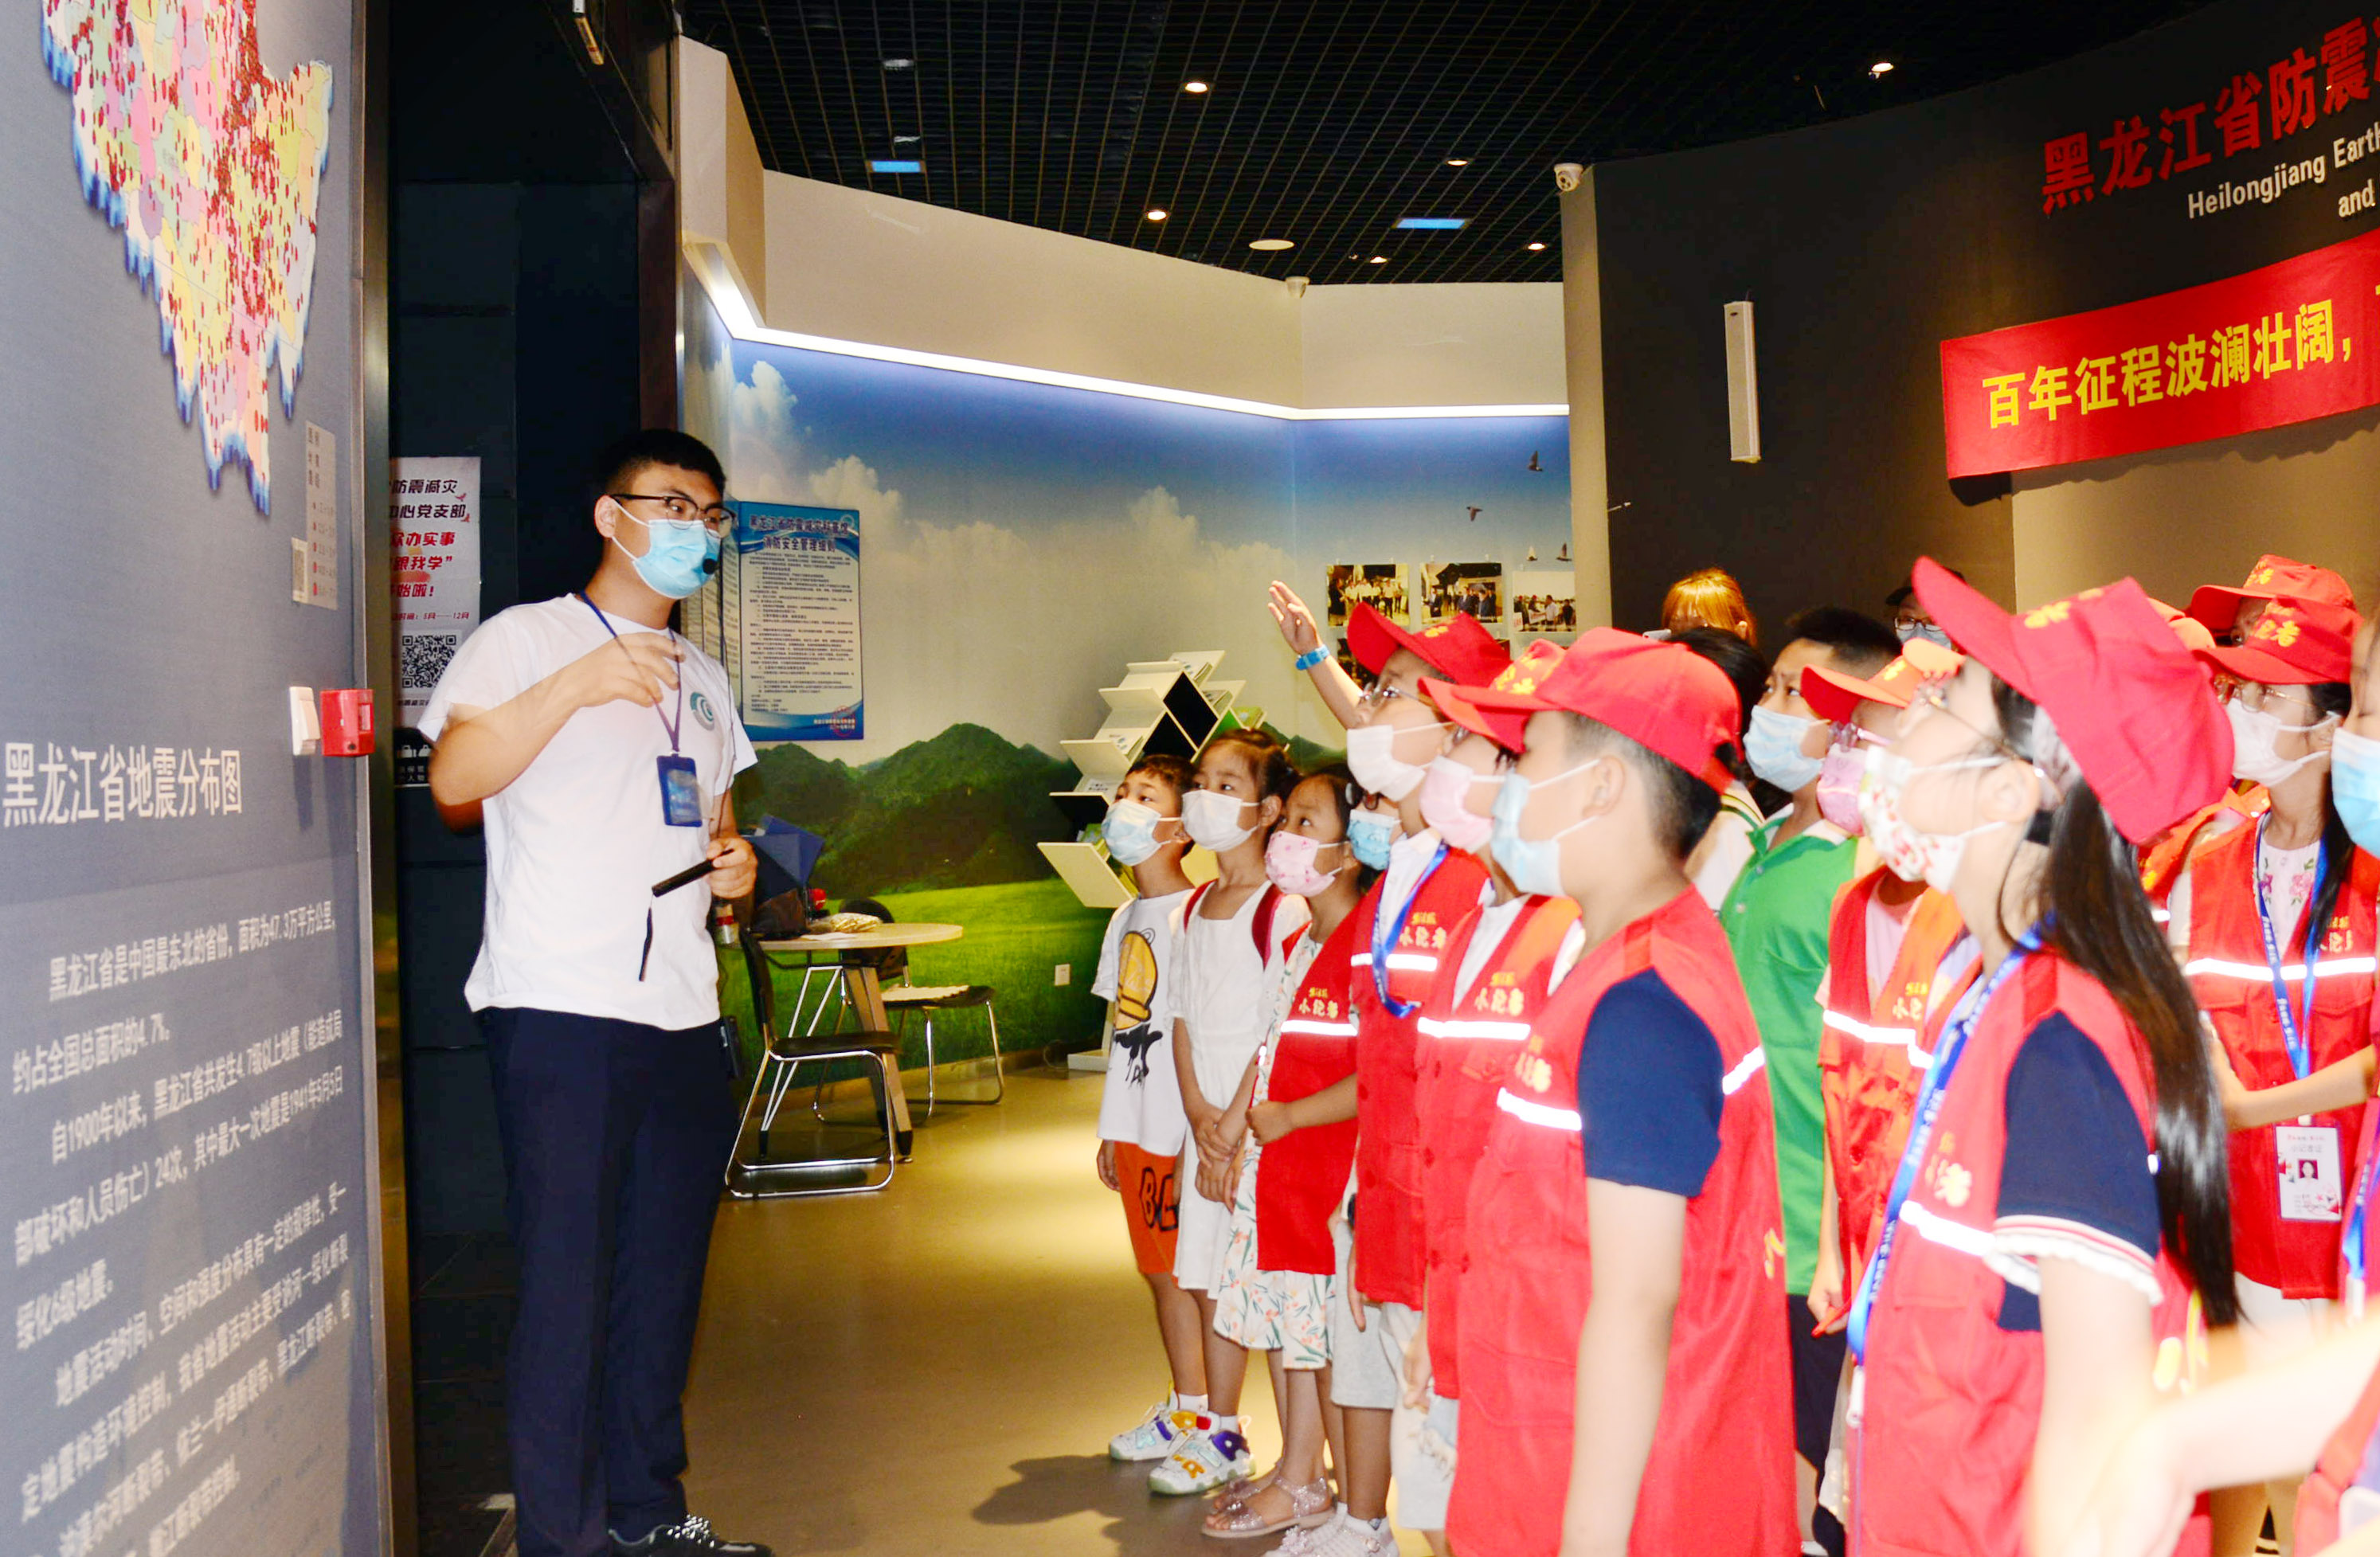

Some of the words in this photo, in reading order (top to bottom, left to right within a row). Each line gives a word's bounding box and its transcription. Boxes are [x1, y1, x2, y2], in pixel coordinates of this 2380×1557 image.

[2187, 154, 2326, 220] Heilongjiang
[2338, 178, 2376, 218] and
[1982, 298, 2352, 429] 百年征程波澜壮阔，
[389, 479, 458, 494] 防震减灾
[3, 741, 243, 828] 黑龙江省地震分布图
